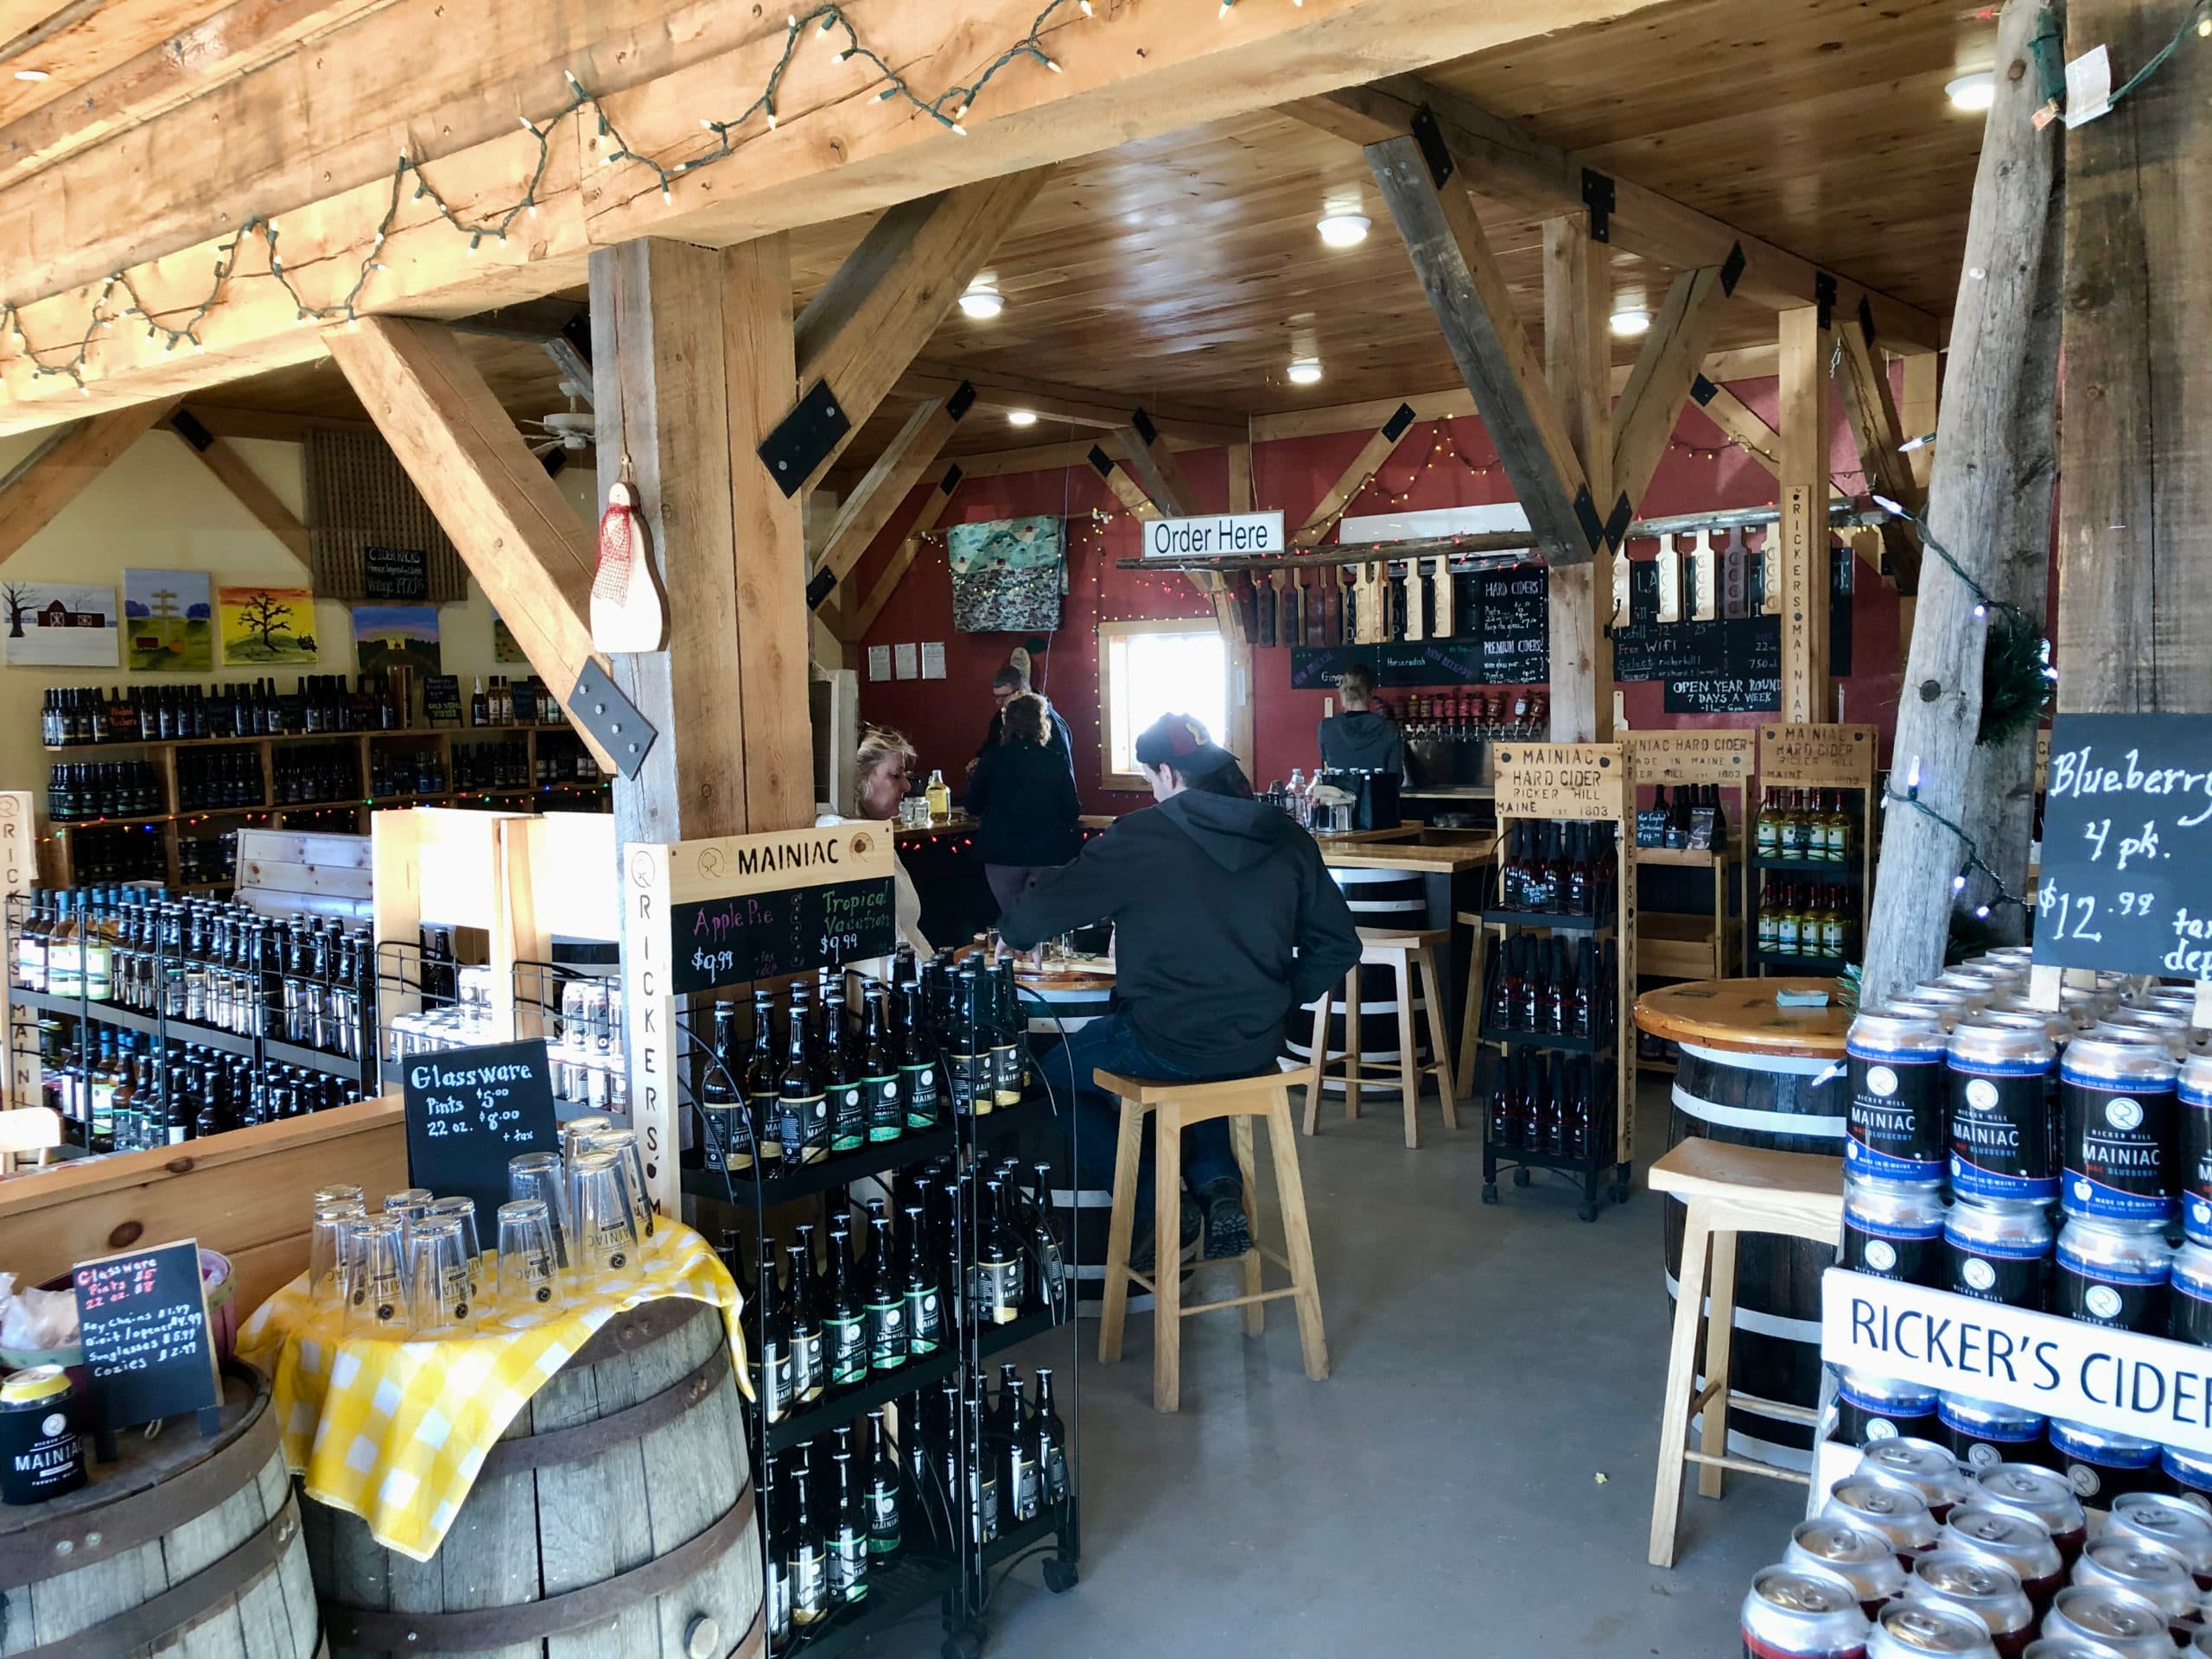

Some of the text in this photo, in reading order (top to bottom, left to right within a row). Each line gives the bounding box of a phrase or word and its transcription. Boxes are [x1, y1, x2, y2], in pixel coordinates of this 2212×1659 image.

[1155, 519, 1268, 554] Order Here
[1792, 504, 1802, 607] RICKERS
[1486, 581, 1538, 597] HARD CIDERS
[1484, 640, 1515, 656] PREMIUM
[1517, 639, 1541, 652] CIDERS
[1618, 644, 1639, 656] Free
[1387, 657, 1426, 667] Horseradish
[1749, 658, 1768, 669] 750
[1673, 678, 1783, 694] OPEN YEAR ROUND
[1687, 692, 1772, 703] 7 DAYS A WEEK
[1785, 728, 1847, 741] MAINIAC
[1676, 739, 1709, 751] HARD
[1714, 739, 1747, 751] CIDER
[1777, 743, 1853, 757] HARD CIDER
[1522, 749, 1594, 765] MAINIAC
[1691, 757, 1725, 766] MAINE
[1513, 770, 1601, 787] HARD CIDER
[1514, 788, 1600, 800] RICKER HILL
[1497, 802, 1608, 817] MAINE 1803
[2084, 819, 2171, 870] 4 pk.
[739, 839, 839, 875] MAINIAC
[823, 880, 889, 916] Tropical
[2039, 878, 2154, 943] $12.99
[692, 899, 774, 943] Apple Pie
[823, 910, 891, 936] Vacation
[820, 933, 858, 964] $9.99
[691, 946, 734, 984] $9.99
[639, 894, 658, 1151] RICKERS
[411, 1065, 532, 1089] Glassware
[426, 1088, 509, 1116] Pints $5.00
[1858, 1094, 1883, 1104] RICKER
[1852, 1106, 1916, 1131] MAINIAC
[1958, 1109, 1984, 1120] RICKER
[427, 1110, 520, 1137] 22 oz. $8.00
[513, 1128, 534, 1141] tax
[1953, 1122, 2020, 1147] MAINIAC
[2091, 1128, 2126, 1139] RICKER
[1970, 1146, 2017, 1157] BLUEBERRY
[2082, 1143, 2161, 1166] MAINIAC
[2107, 1167, 2158, 1178] BLUEBERRY
[77, 1259, 157, 1286] Glassware
[87, 1280, 126, 1296] Pints
[1953, 1284, 1979, 1297] RICKER
[85, 1297, 105, 1311] 22
[83, 1321, 105, 1334] Key
[88, 1339, 159, 1363] Sunglasses
[1851, 1298, 2062, 1392] RICKER'S
[93, 1357, 148, 1377] Cozies
[15, 1434, 83, 1471] MAINIAC
